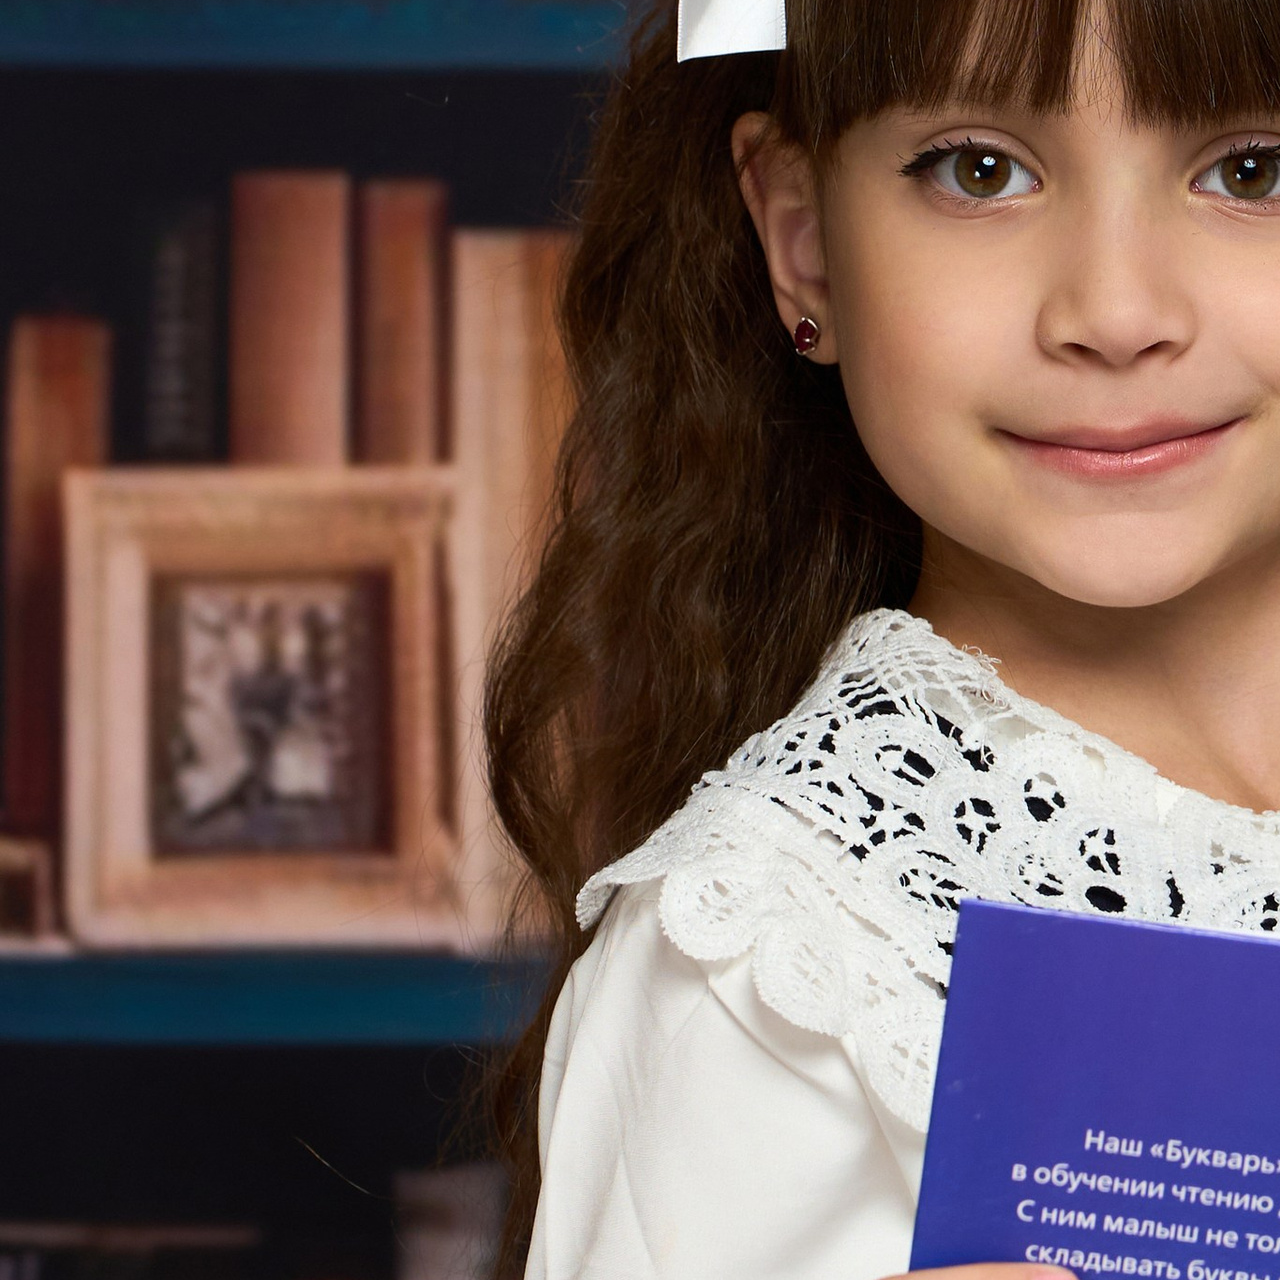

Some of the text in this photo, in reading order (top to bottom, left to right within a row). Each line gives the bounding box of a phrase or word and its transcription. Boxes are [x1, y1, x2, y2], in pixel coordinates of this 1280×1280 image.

[1084, 1128, 1143, 1157] Наш
[1011, 1163, 1027, 1182] в
[1033, 1162, 1165, 1199] обучении
[1171, 1184, 1274, 1213] чтению
[1016, 1199, 1036, 1222] С
[1040, 1206, 1097, 1230] ним
[1103, 1214, 1199, 1243] малыш
[1205, 1228, 1239, 1249] не
[1025, 1244, 1181, 1280] складывать
